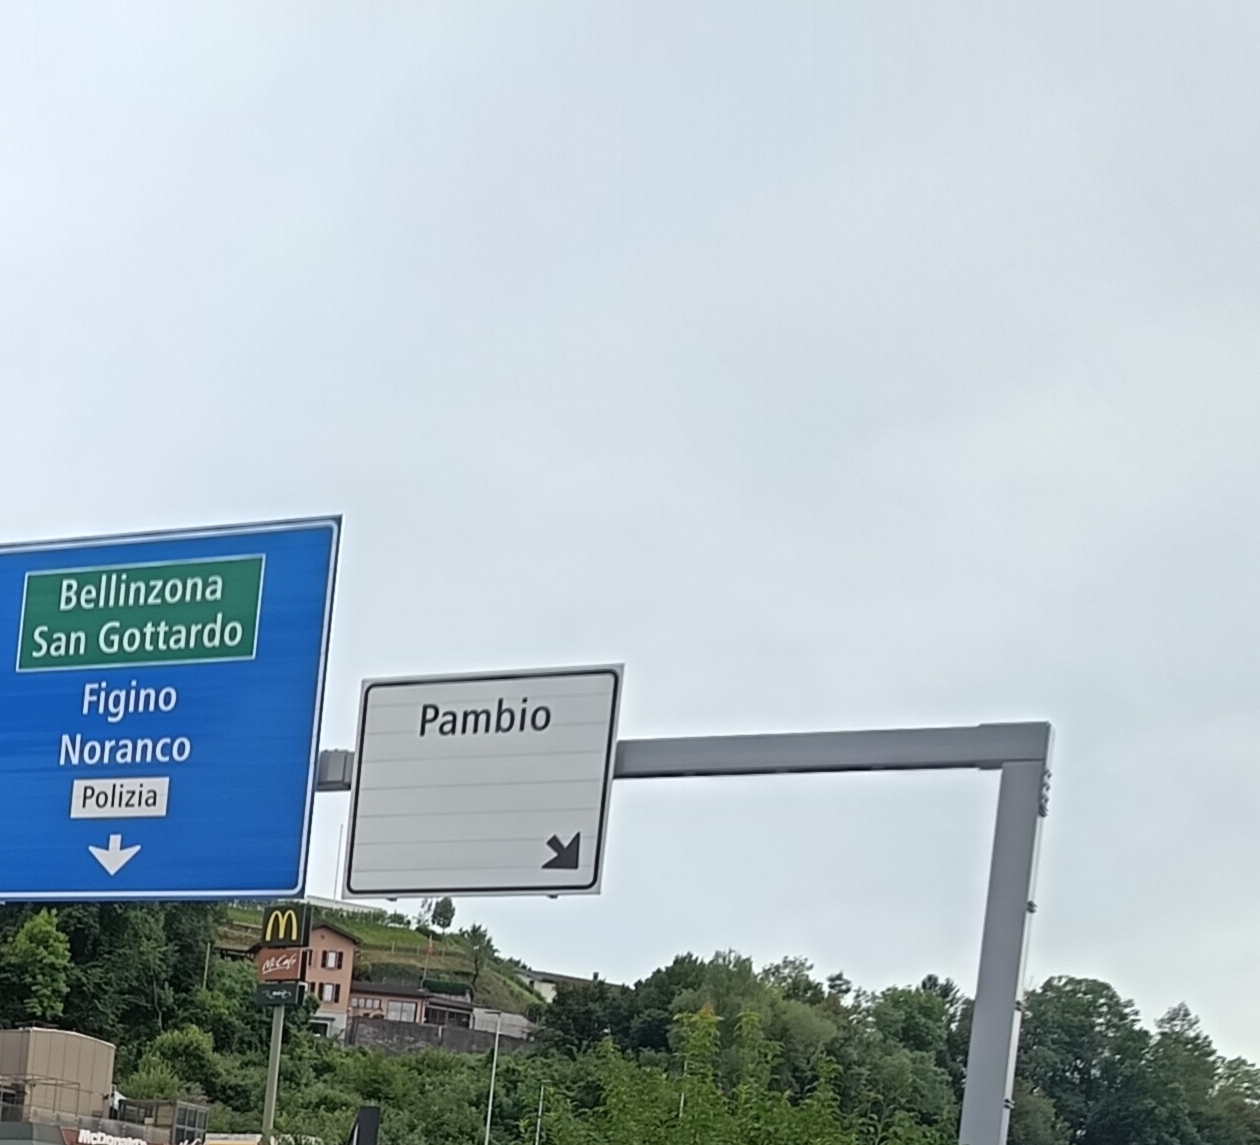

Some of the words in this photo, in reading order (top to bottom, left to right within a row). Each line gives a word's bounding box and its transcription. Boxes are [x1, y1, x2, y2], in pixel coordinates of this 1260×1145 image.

[59, 573, 224, 612] Bellinzona
[31, 625, 86, 659] San
[98, 612, 243, 655] Gottardo
[81, 679, 178, 723] Figino
[418, 696, 552, 738] Pambio
[58, 733, 192, 767] Noranco
[81, 783, 159, 810] Polizia
